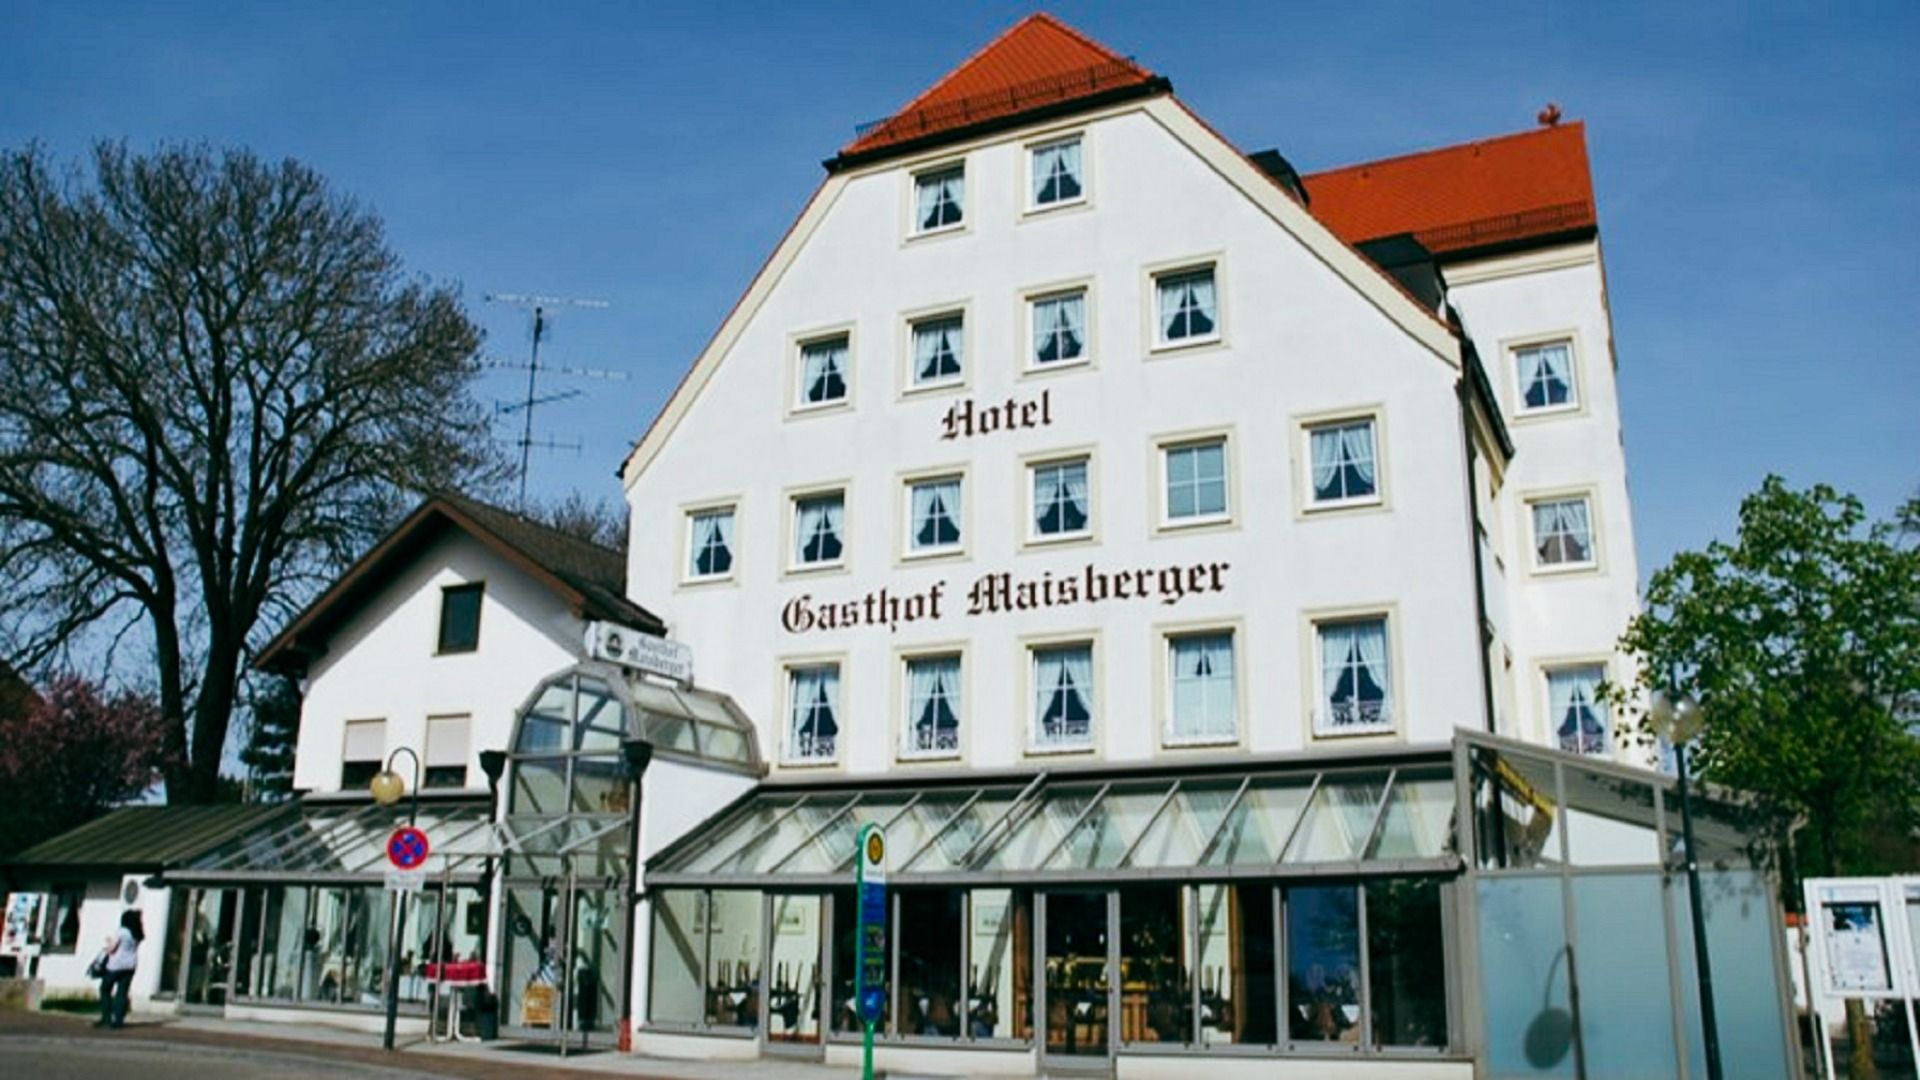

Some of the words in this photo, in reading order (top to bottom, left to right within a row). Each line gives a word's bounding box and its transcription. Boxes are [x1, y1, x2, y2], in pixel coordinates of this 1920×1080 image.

[941, 389, 1052, 440] Hotel
[781, 580, 946, 633] Gasthof
[966, 561, 1231, 616] Maisberger
